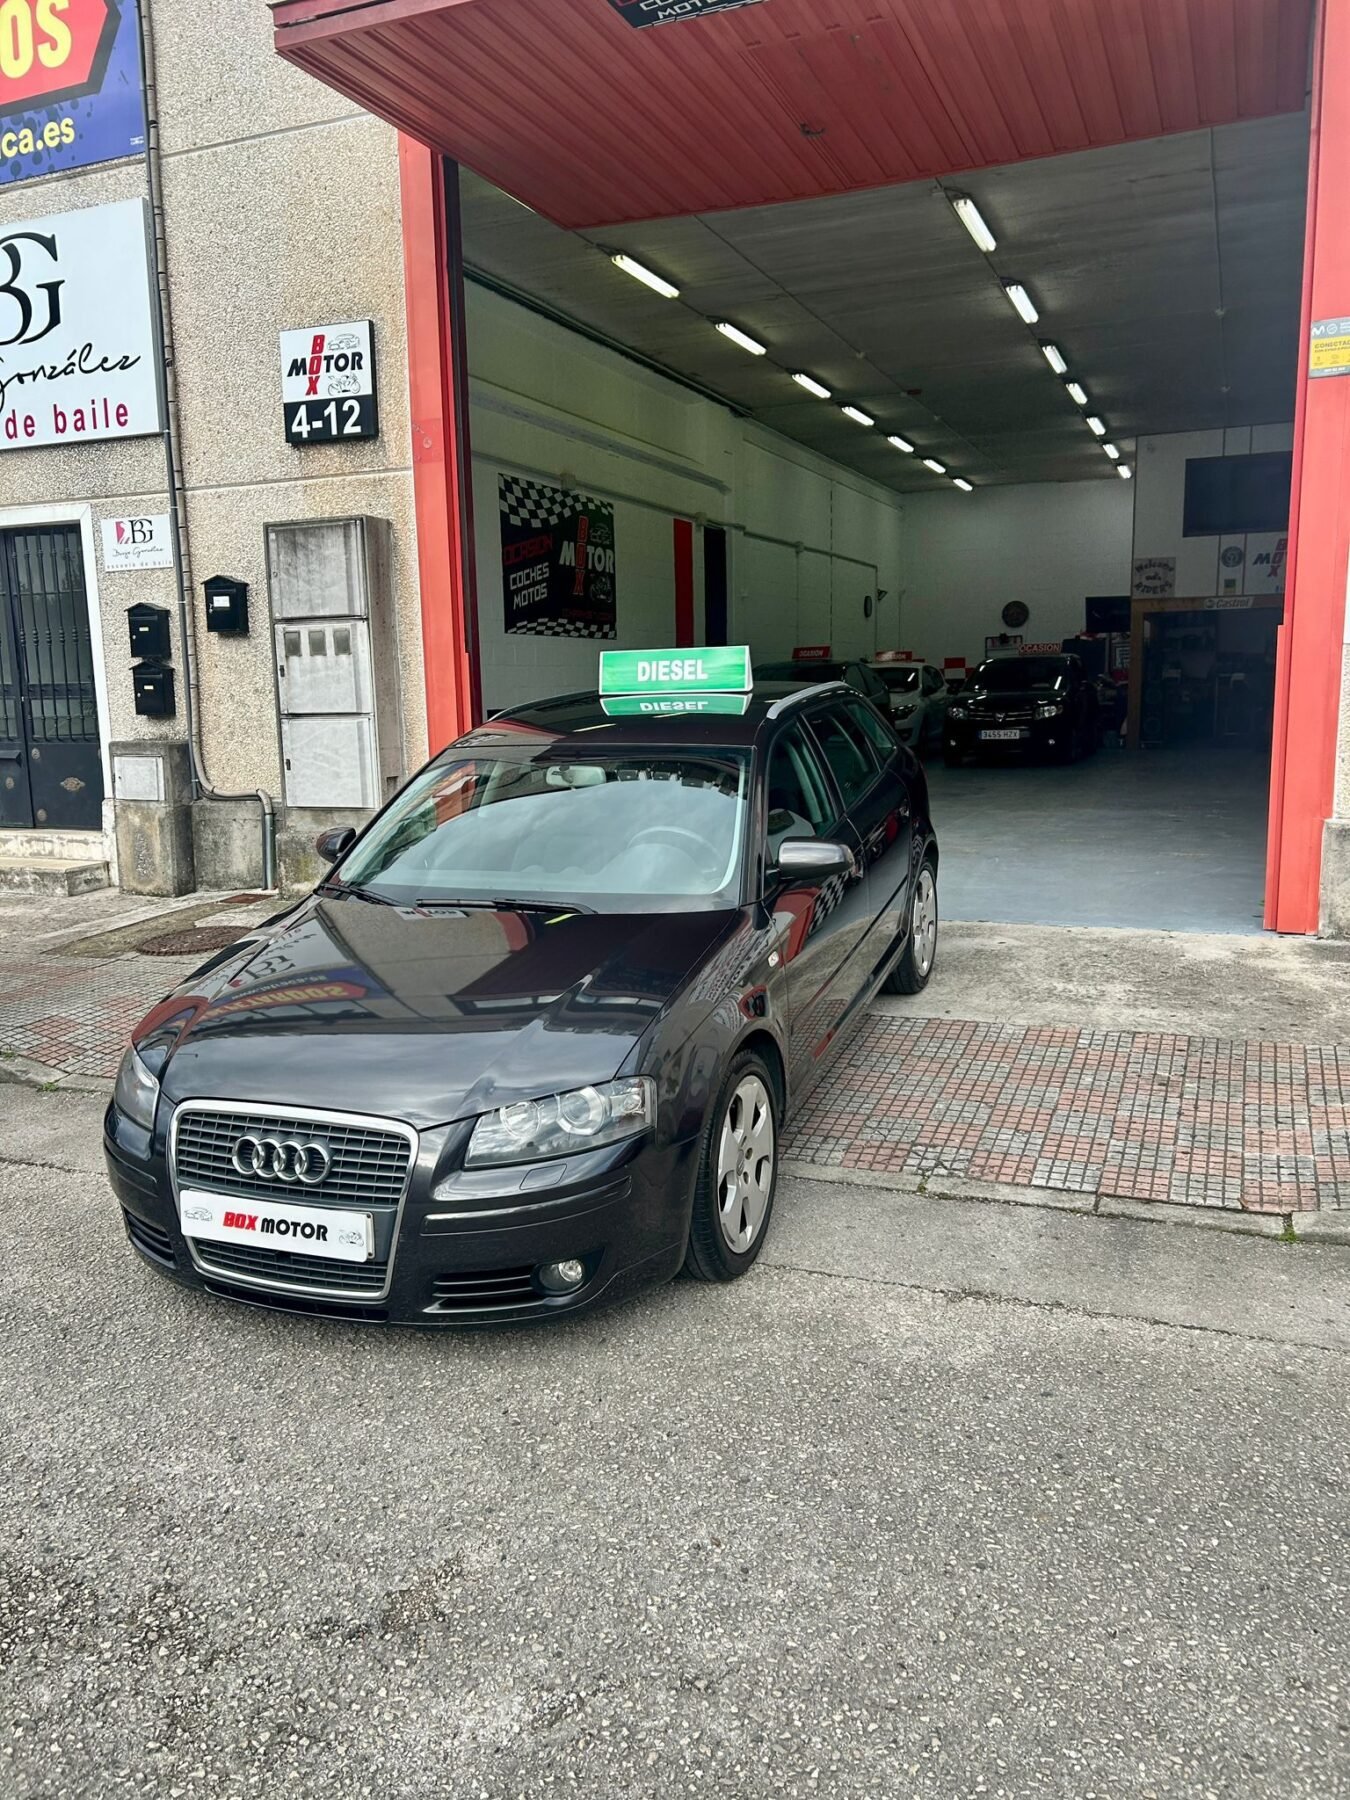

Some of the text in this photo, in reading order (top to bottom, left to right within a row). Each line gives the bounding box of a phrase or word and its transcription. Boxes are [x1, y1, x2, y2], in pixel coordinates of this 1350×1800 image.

[0, 342, 141, 414] onzález
[287, 351, 363, 377] MOTOR
[305, 334, 325, 396] BOX
[5, 397, 129, 440] de baile
[291, 399, 362, 438] 4-12
[128, 518, 154, 543] BG
[559, 540, 615, 574] MOTOR
[509, 562, 550, 590] COCHES
[513, 583, 548, 610] MOTOS
[1216, 599, 1249, 609] Castrol
[1020, 643, 1060, 653] OCASION
[637, 659, 708, 682] DIESEL
[223, 1211, 328, 1242] BOX MOTOR
